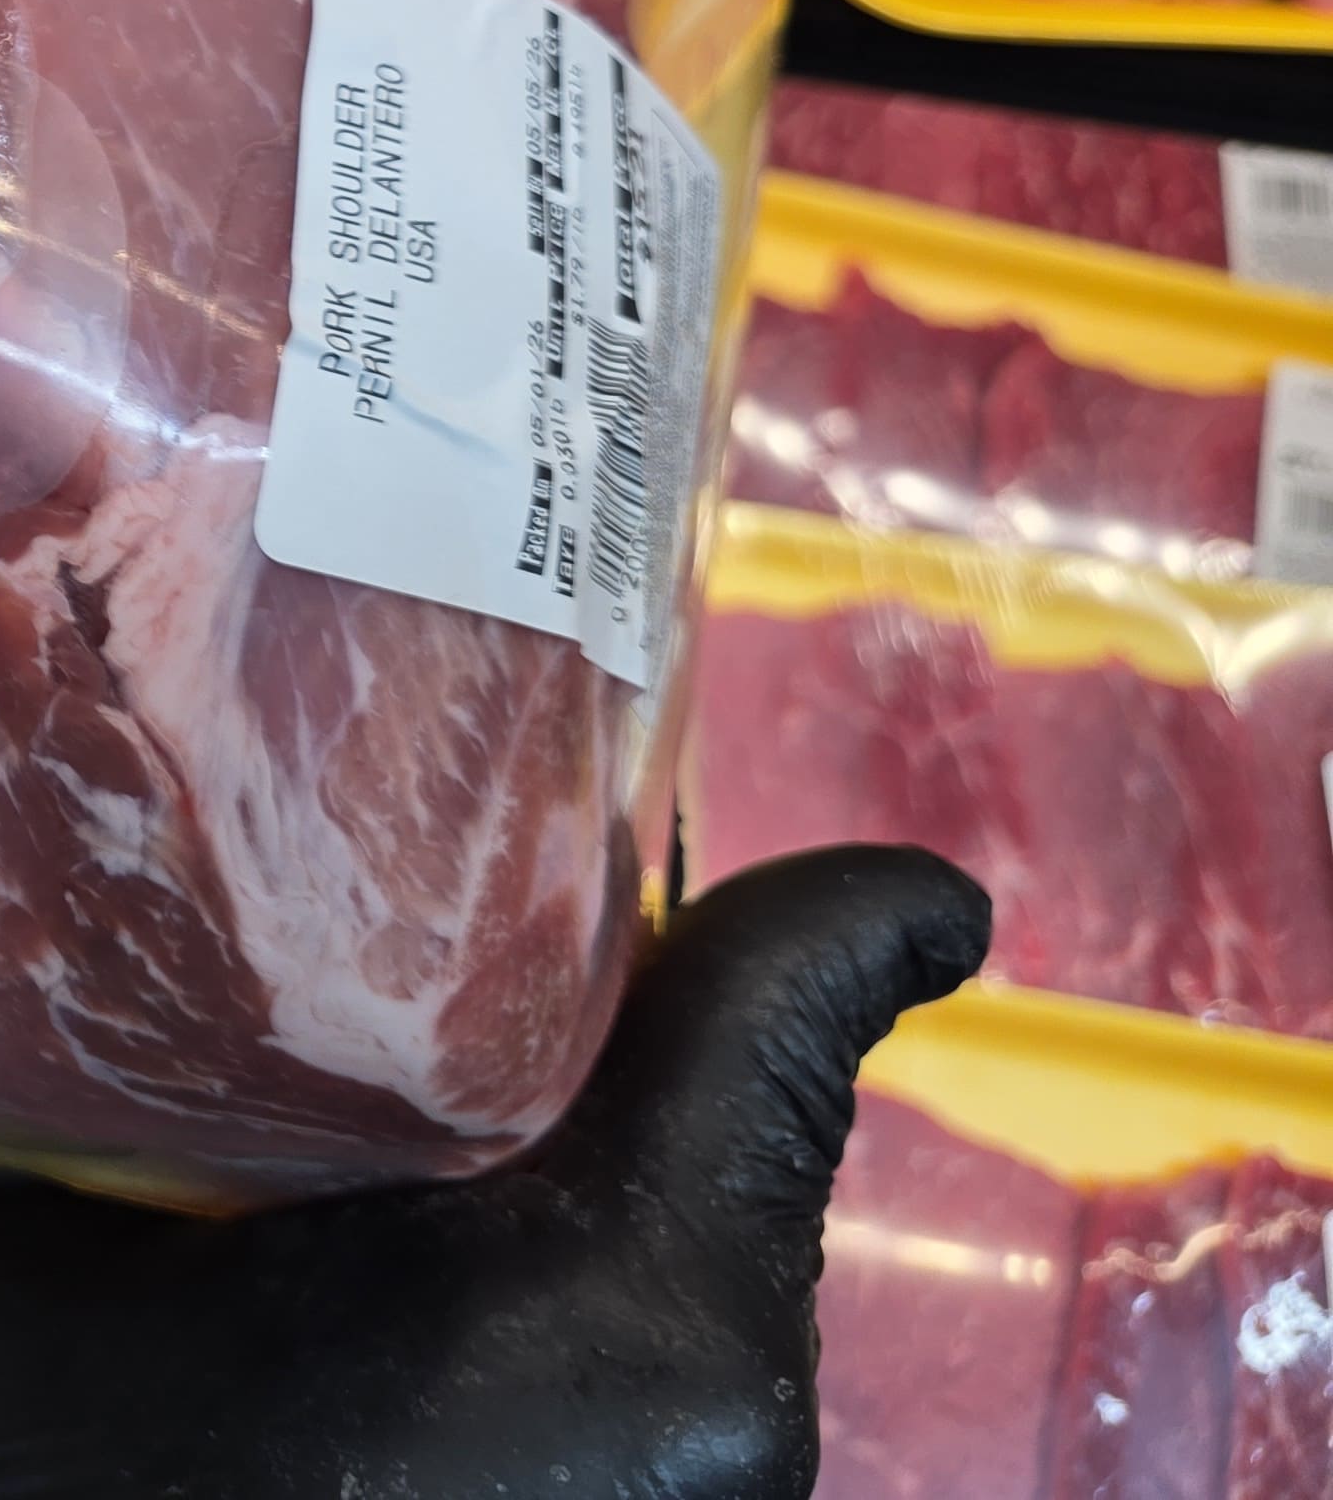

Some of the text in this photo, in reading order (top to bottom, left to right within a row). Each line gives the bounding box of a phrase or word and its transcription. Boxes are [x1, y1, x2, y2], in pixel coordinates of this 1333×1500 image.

[525, 35, 543, 156] 05/05/26
[317, 82, 367, 378] PORK SHOULDER
[353, 63, 405, 424] PERNIL DELANTERO
[405, 219, 437, 285] USA
[516, 319, 550, 568] Packed On 05/01/26
[552, 527, 575, 595] Tare
